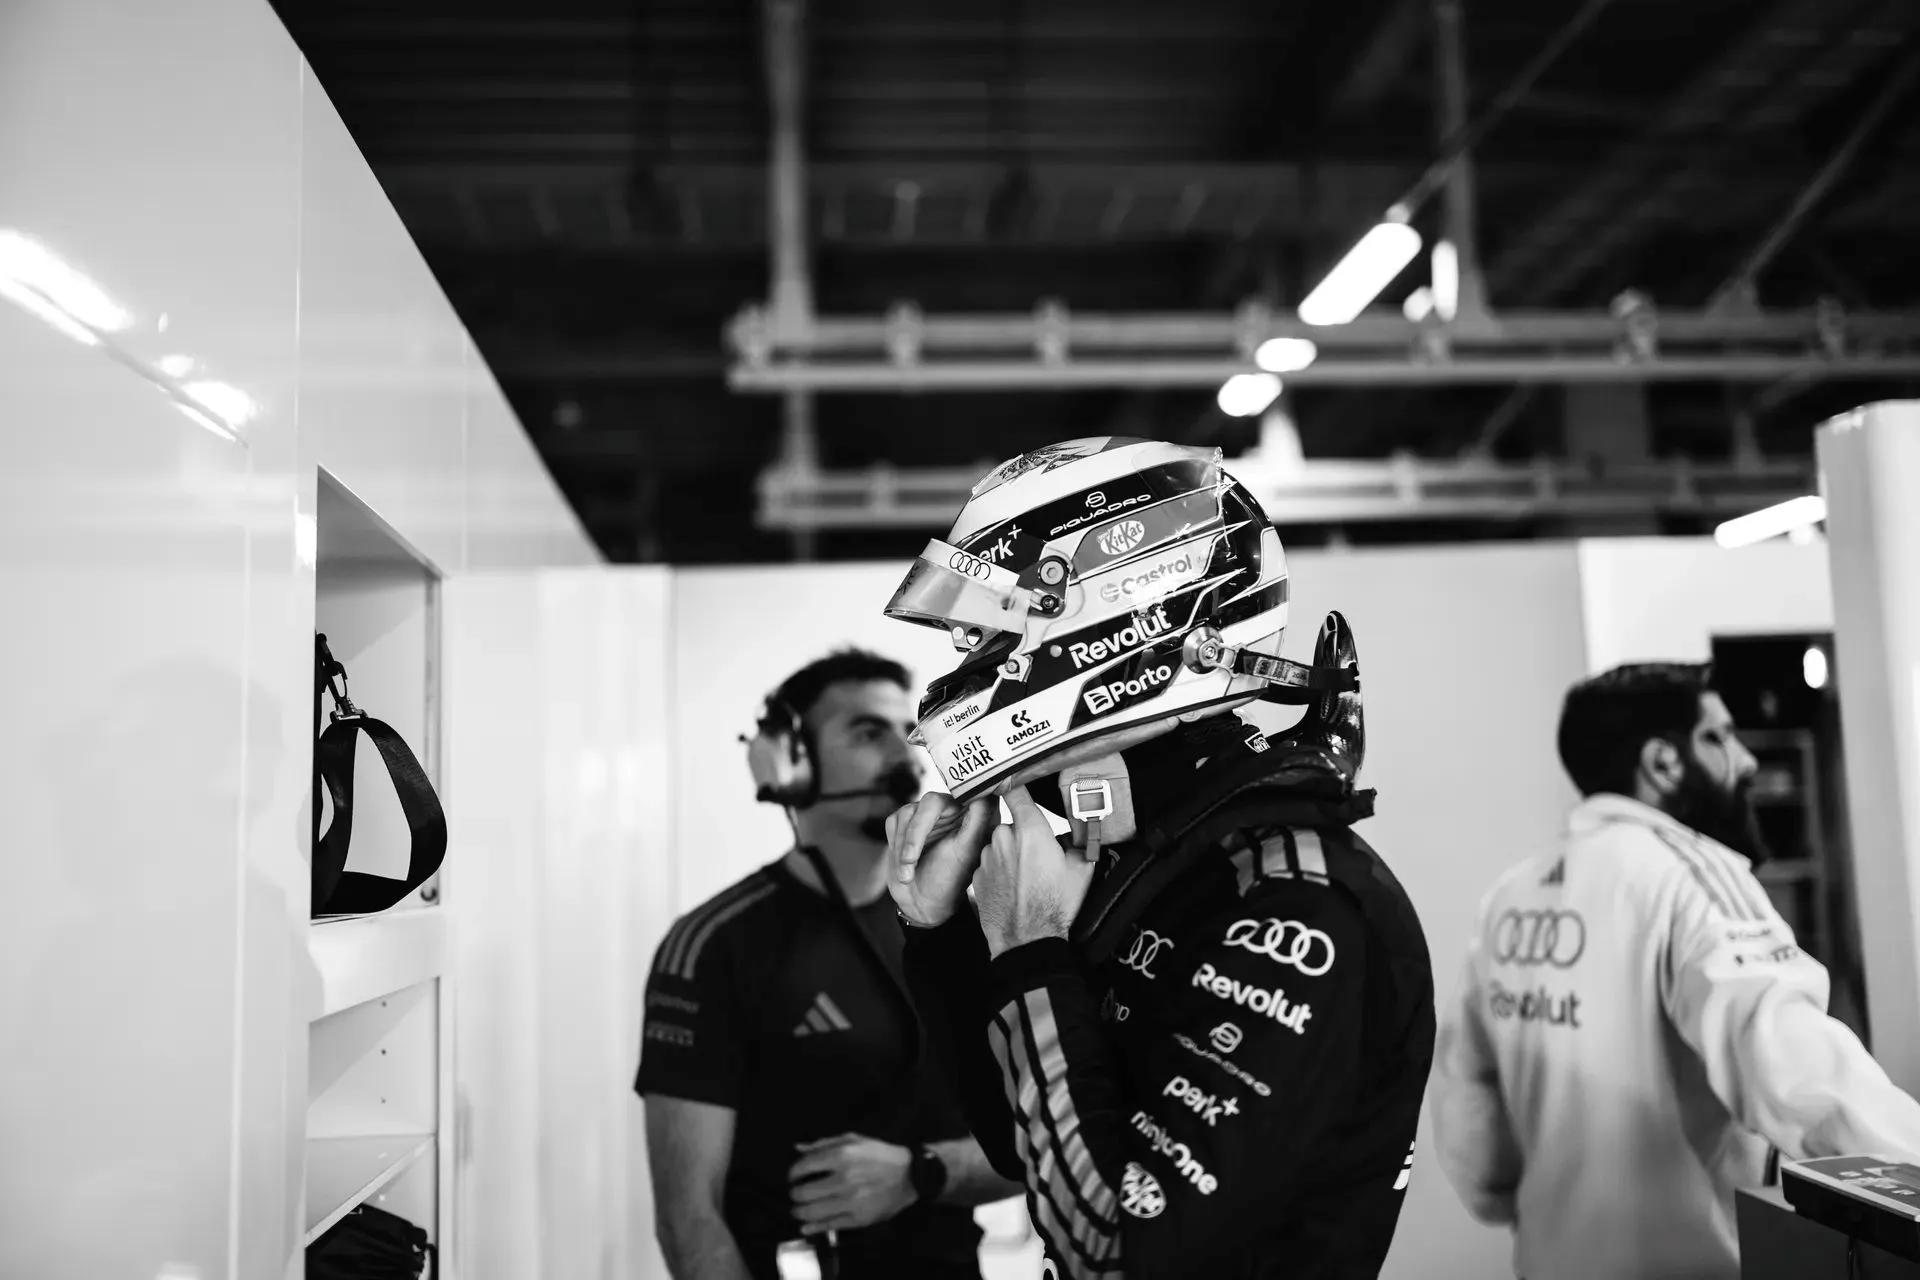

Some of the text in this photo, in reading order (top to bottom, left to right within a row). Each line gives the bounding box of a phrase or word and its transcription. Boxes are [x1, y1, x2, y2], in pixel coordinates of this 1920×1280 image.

[1050, 494, 1151, 536] PIQUADRO
[1104, 522, 1143, 553] KitKat
[1121, 554, 1192, 595] Castrol
[1068, 605, 1172, 669] Revolut
[1108, 665, 1172, 703] Porto
[953, 704, 981, 723] berlin
[951, 735, 985, 761] visit
[1006, 719, 1051, 746] CAMOZZI
[948, 749, 994, 781] QATAR
[1192, 962, 1312, 1035] Revolut
